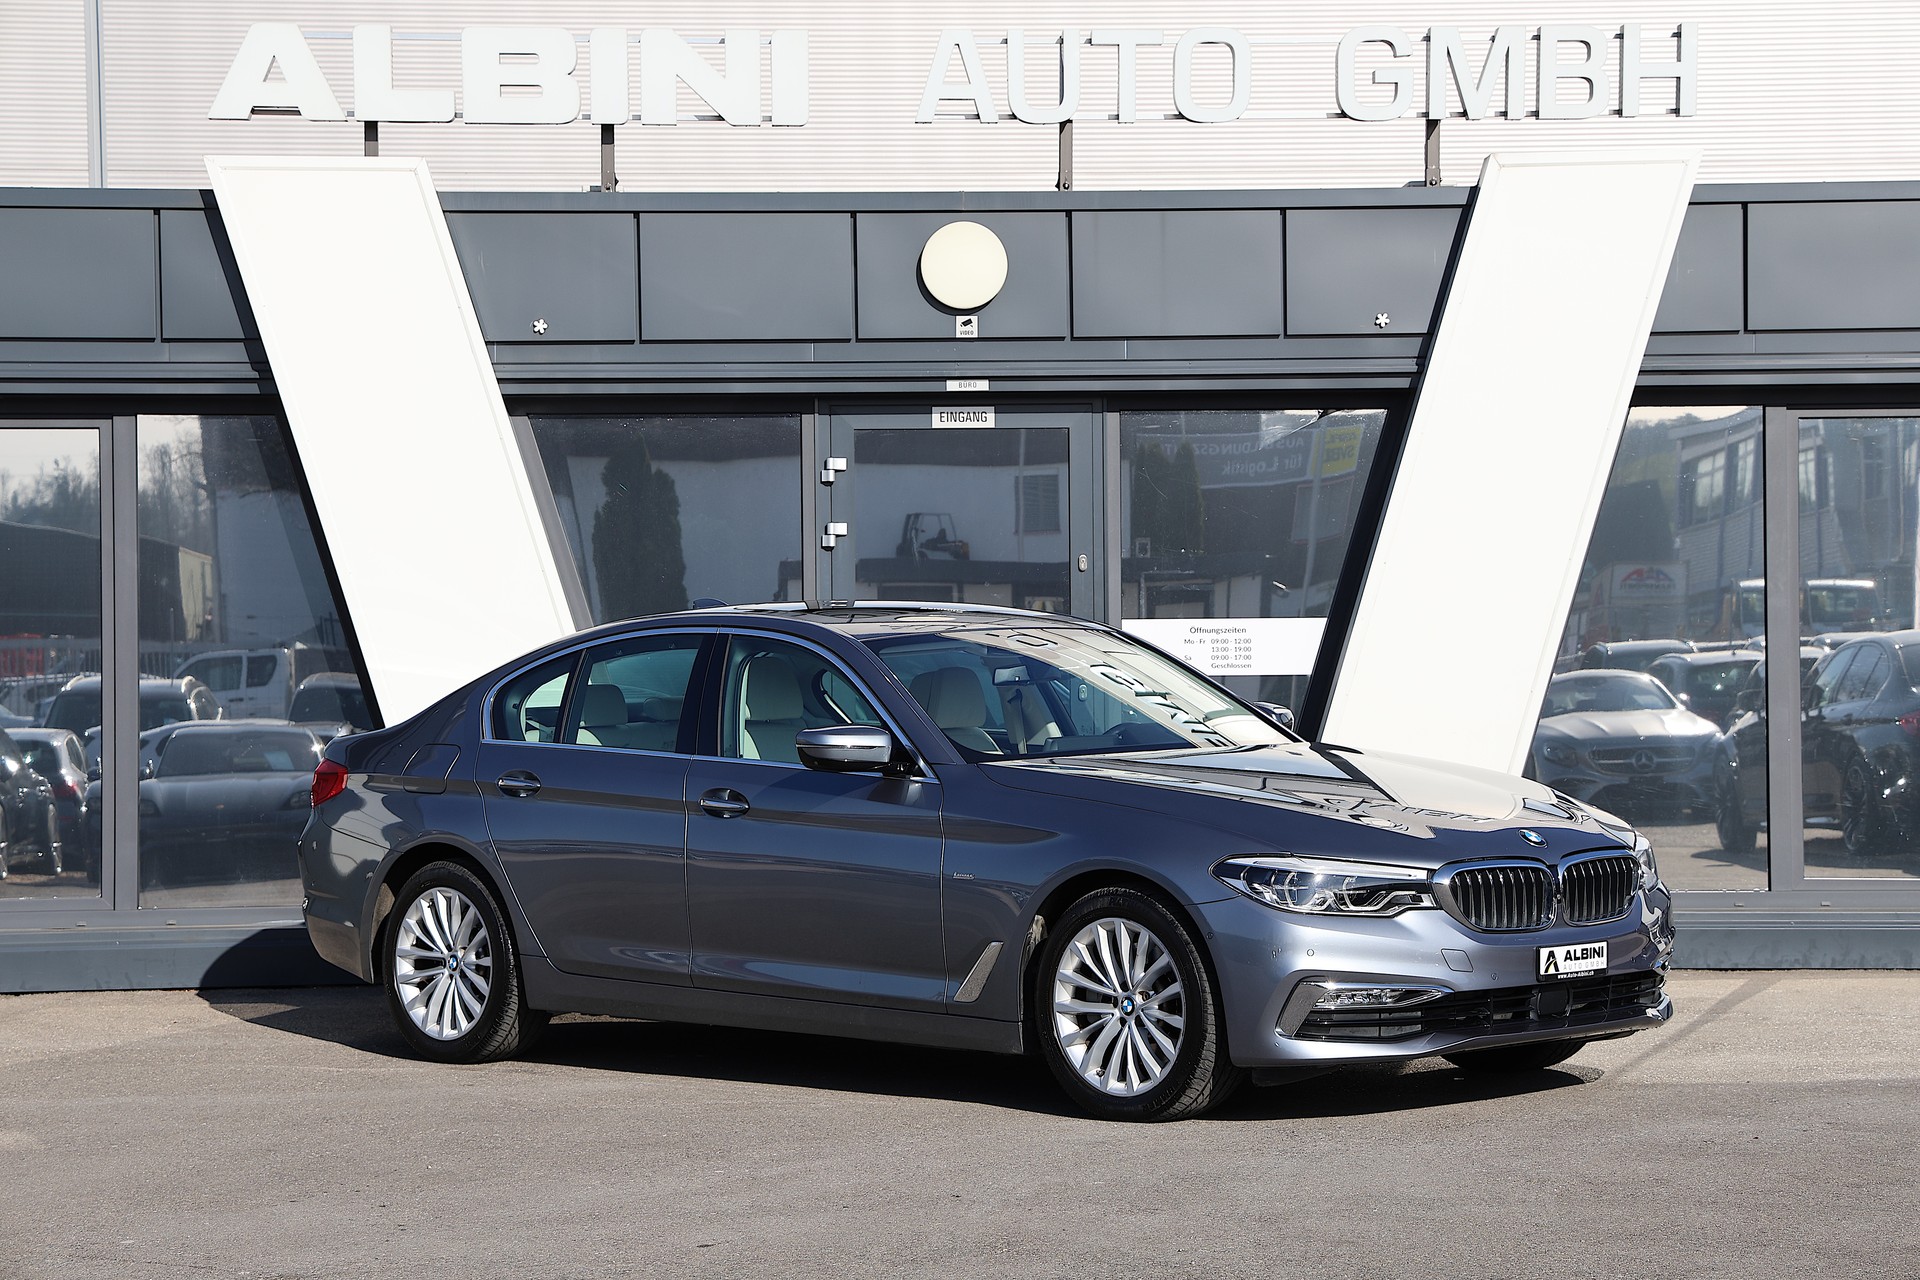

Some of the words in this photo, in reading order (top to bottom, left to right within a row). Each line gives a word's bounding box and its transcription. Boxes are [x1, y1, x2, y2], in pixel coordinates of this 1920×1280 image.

[207, 22, 809, 127] ALBINI
[915, 27, 1251, 125] AUTO
[1335, 22, 1699, 122] GMBH
[958, 380, 977, 389] BÜRO
[939, 411, 988, 423] EINGANG
[1189, 626, 1247, 635] Öffnungszeiten
[1564, 946, 1604, 962] ALBINI
